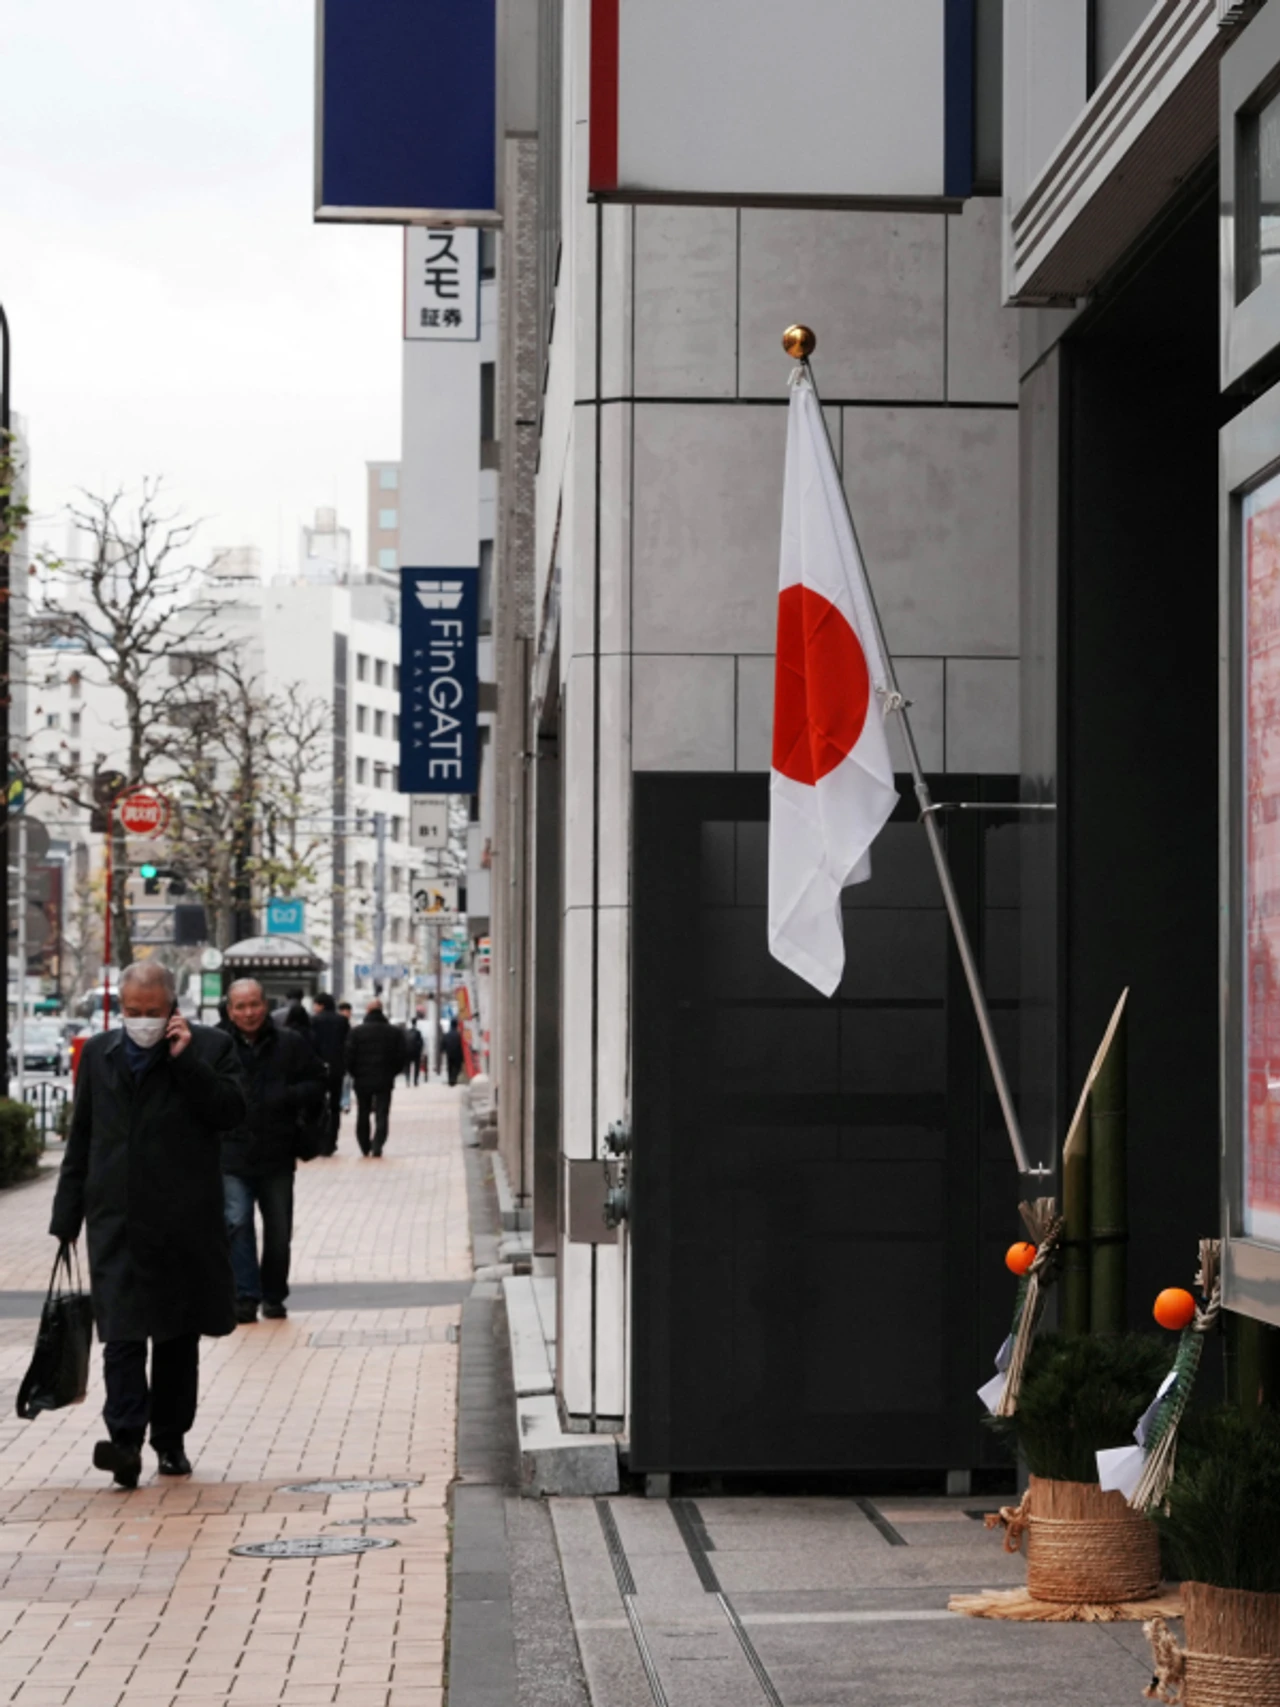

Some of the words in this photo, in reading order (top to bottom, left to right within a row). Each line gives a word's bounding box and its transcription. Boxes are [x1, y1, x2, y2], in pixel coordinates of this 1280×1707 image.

[424, 227, 459, 299] スモ
[420, 307, 462, 328] 証券
[412, 649, 424, 748] KAYABA
[428, 619, 463, 779] FinGATE
